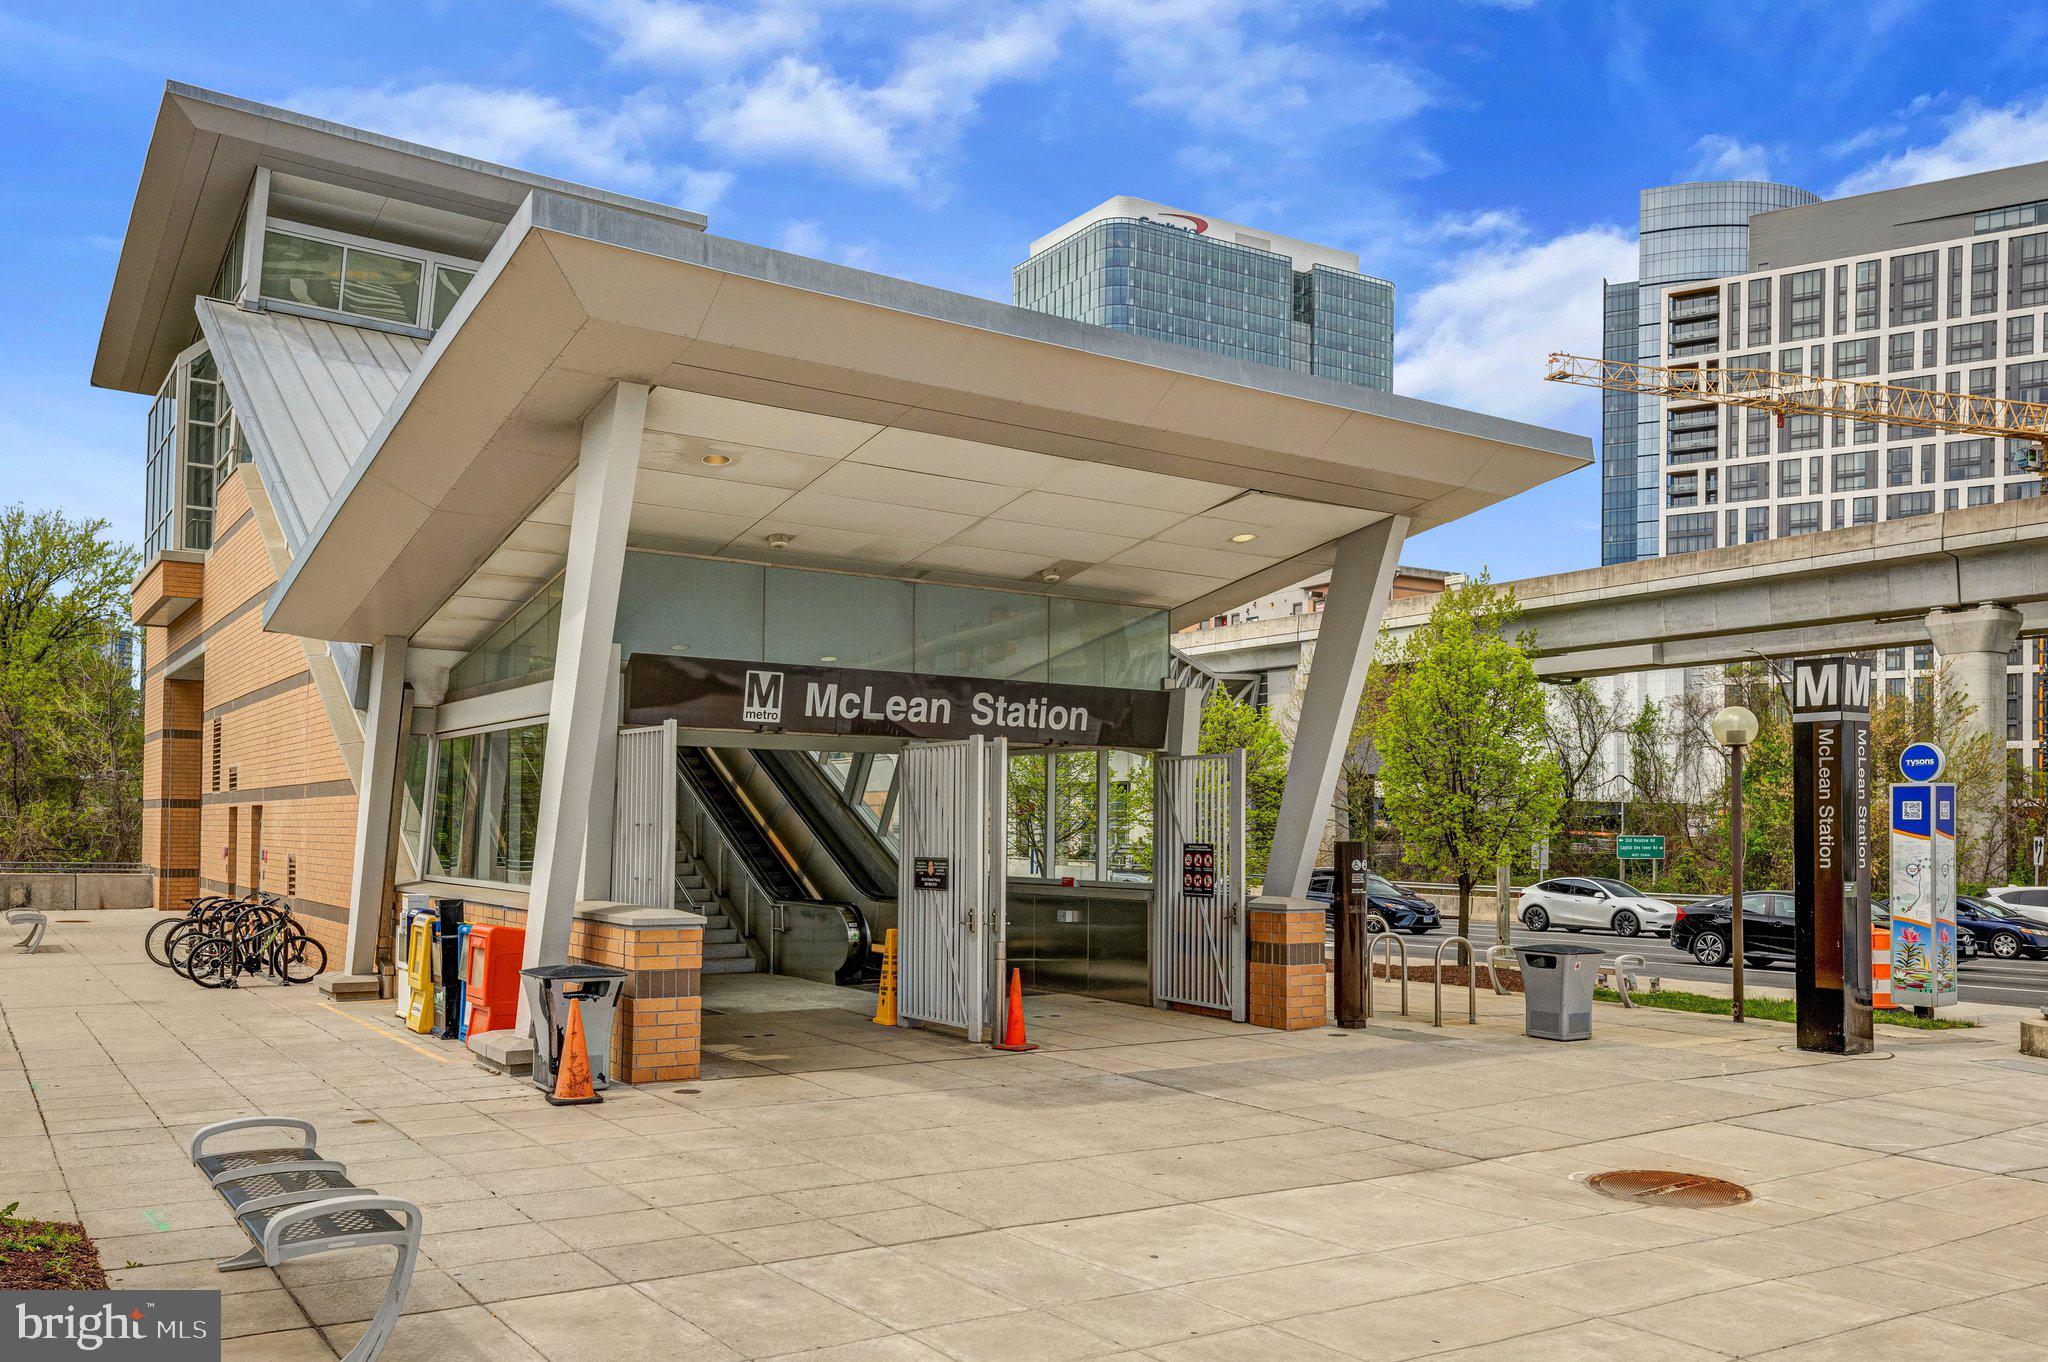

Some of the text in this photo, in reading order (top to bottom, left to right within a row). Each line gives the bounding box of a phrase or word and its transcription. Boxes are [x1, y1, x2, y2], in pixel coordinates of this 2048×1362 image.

[746, 673, 782, 709] M
[804, 682, 1089, 732] McLean Station
[1796, 664, 1838, 707] M
[1844, 664, 1871, 707] M
[745, 710, 779, 720] metro
[1906, 758, 1935, 767] Tysons
[1818, 728, 1835, 869] McLean Station
[1858, 729, 1868, 869] McLean Station
